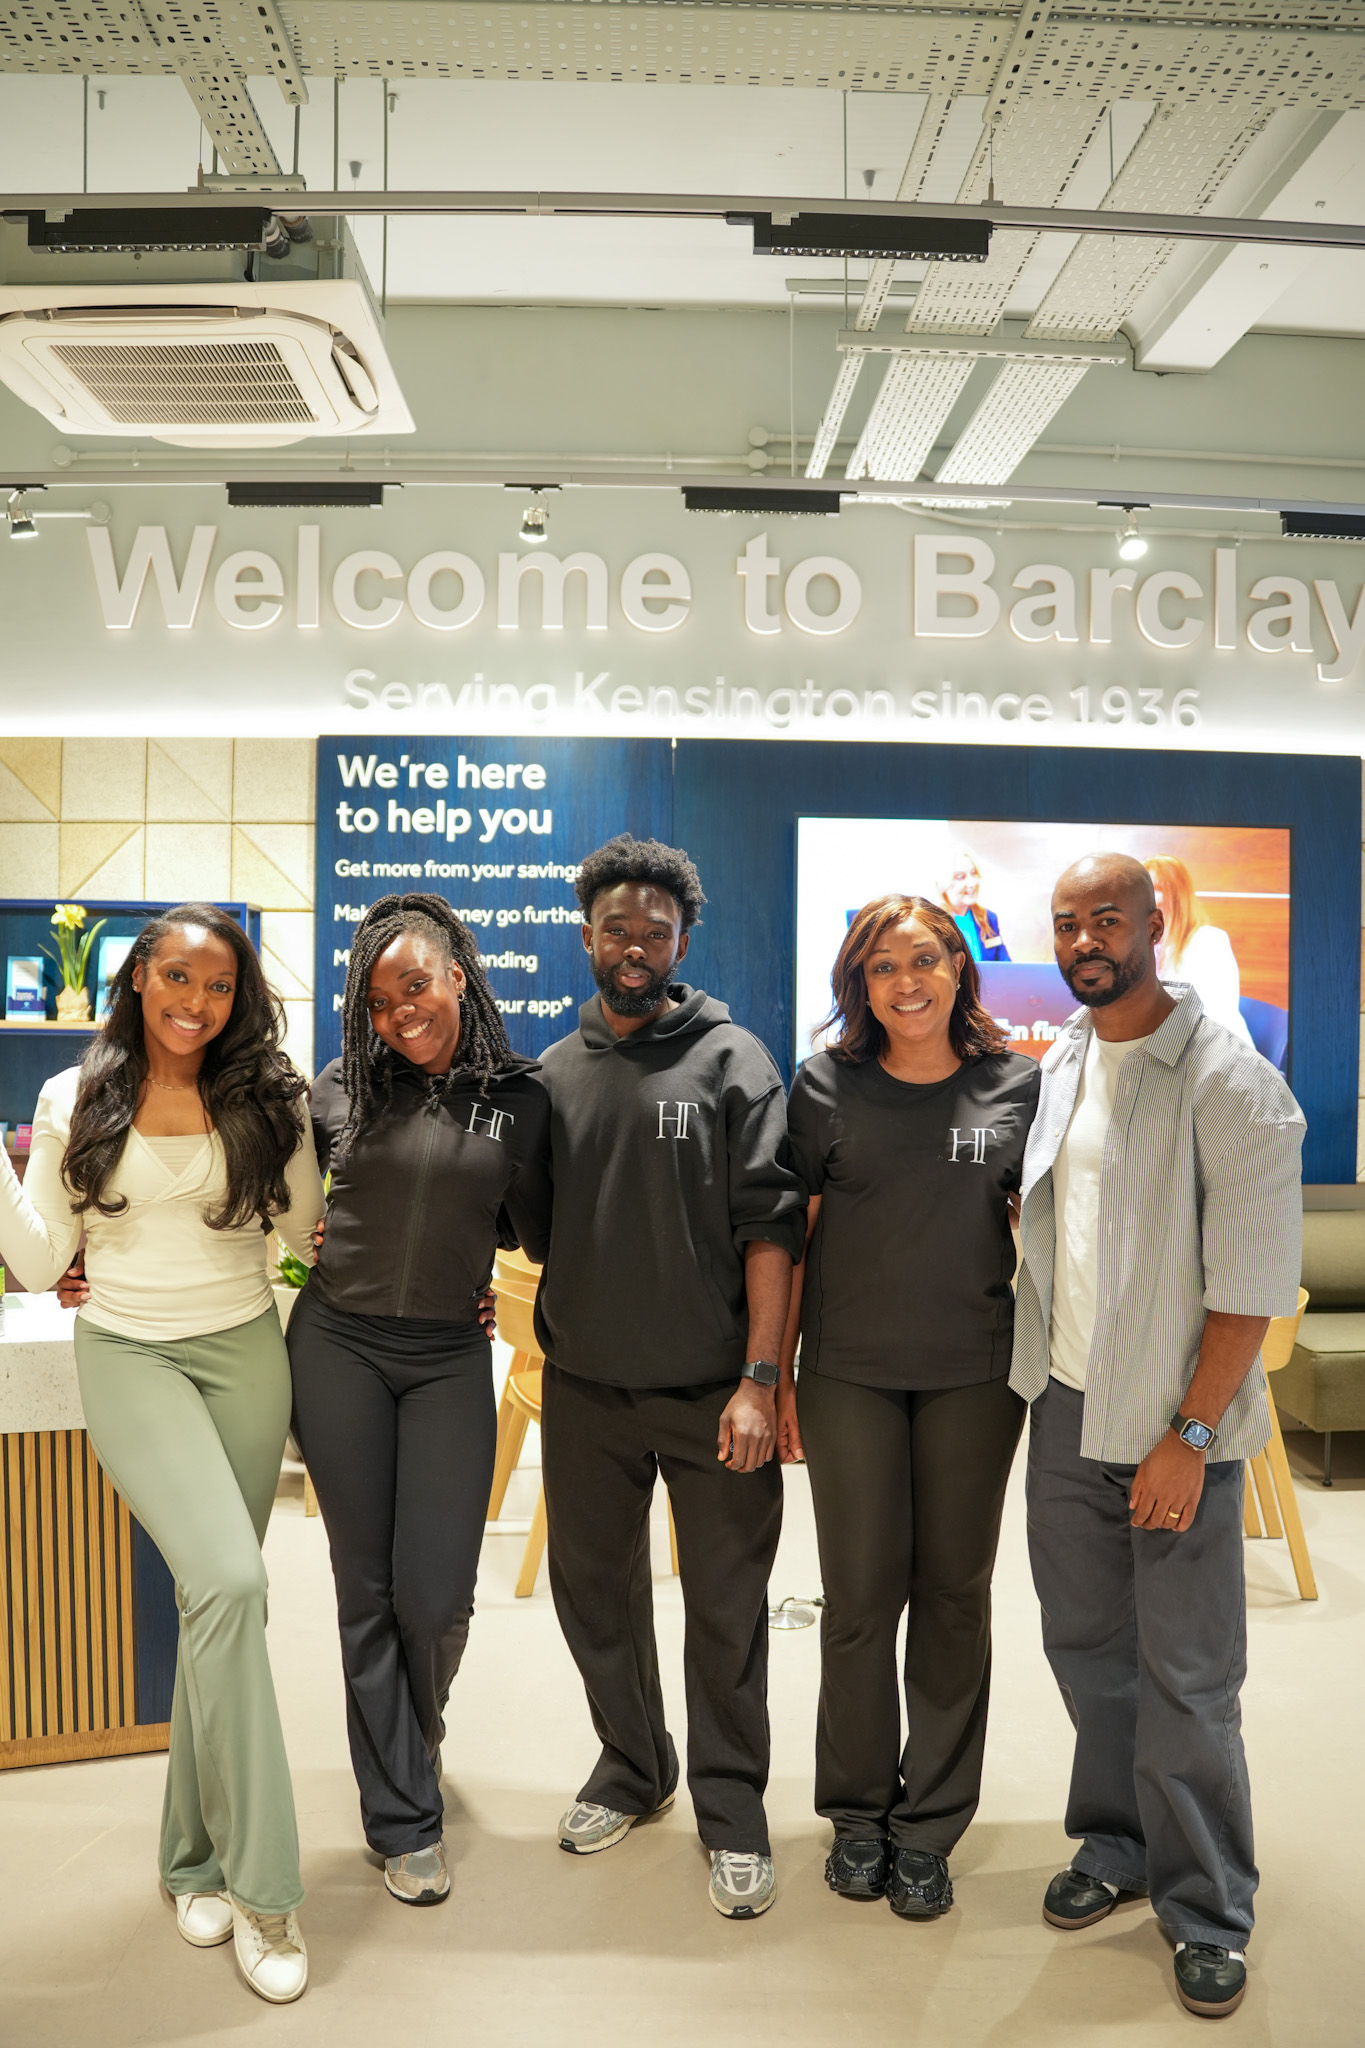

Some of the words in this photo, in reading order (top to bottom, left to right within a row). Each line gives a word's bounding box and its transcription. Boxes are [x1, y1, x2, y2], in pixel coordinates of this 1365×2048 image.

[86, 525, 691, 631] Welcome
[736, 532, 862, 636] to
[344, 668, 556, 725] Serving
[574, 671, 895, 729] Kensington
[911, 681, 1054, 725] since
[1070, 685, 1201, 729] 1936
[457, 755, 546, 790] here
[336, 801, 379, 833] to
[387, 800, 472, 842] help
[479, 808, 553, 843] you
[334, 859, 370, 878] Get
[373, 863, 422, 878] more
[424, 859, 470, 879] from
[471, 864, 515, 883] your
[496, 909, 522, 928] go
[495, 999, 526, 1015] our
